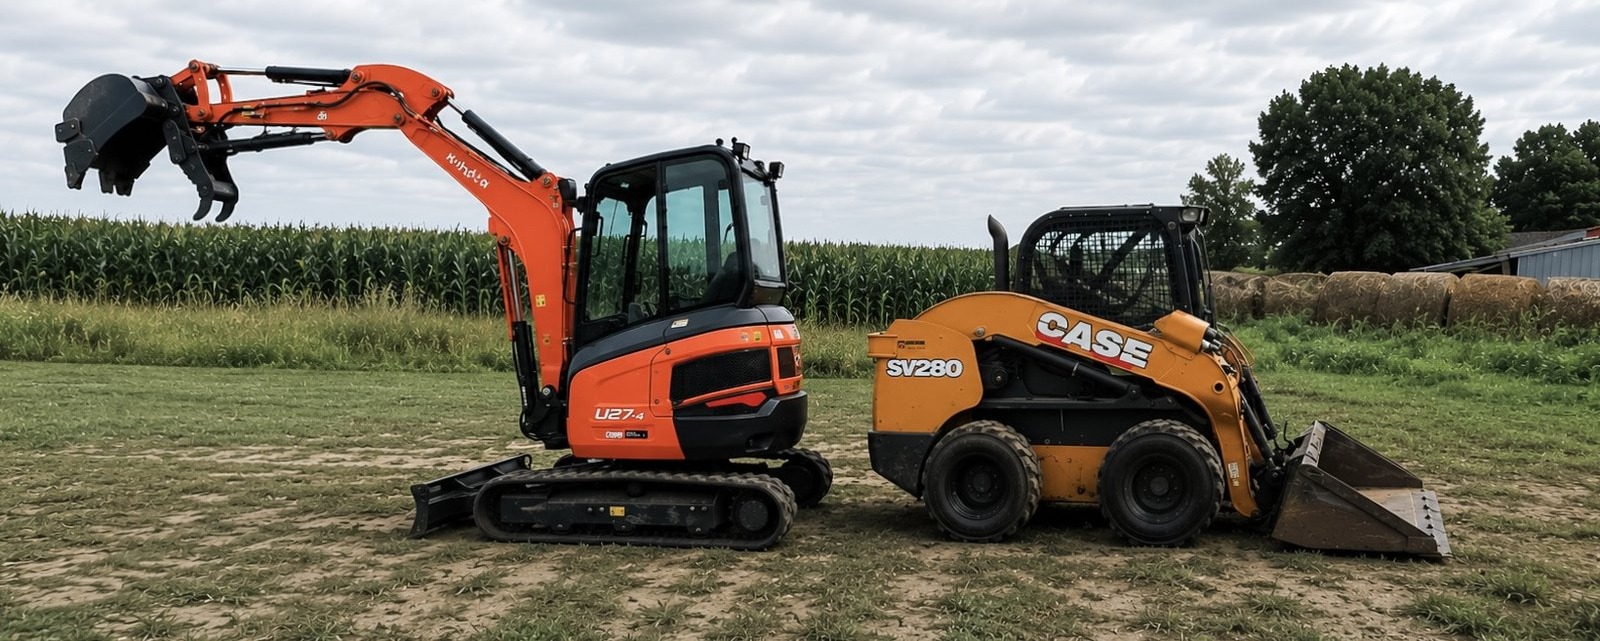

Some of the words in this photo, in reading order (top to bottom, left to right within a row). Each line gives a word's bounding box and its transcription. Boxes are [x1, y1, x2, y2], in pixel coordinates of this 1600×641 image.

[1036, 310, 1154, 369] CASE
[886, 358, 964, 378] SV280
[594, 408, 645, 420] U27-4
